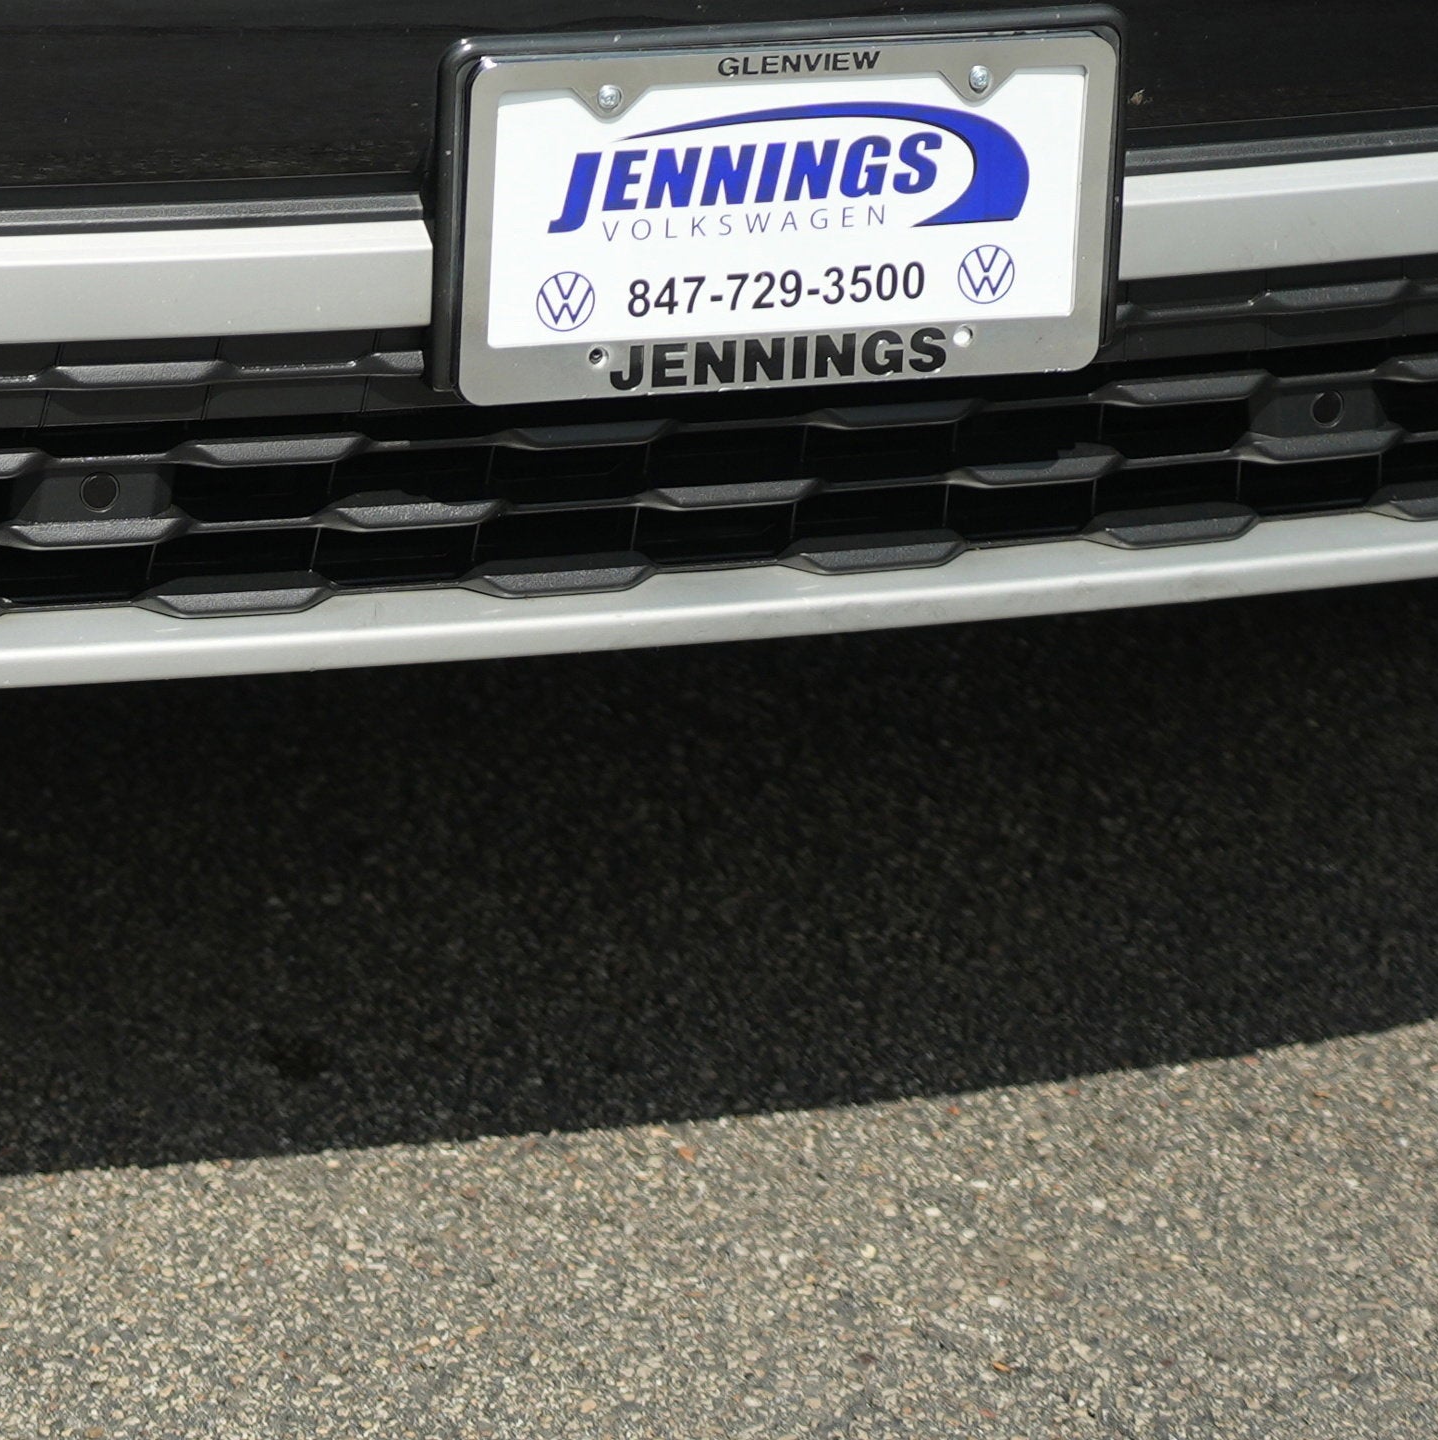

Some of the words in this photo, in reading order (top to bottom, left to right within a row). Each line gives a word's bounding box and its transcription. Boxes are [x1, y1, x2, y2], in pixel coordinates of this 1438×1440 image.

[717, 51, 880, 76] GLENVIEW
[547, 132, 943, 233] JENNINGS
[602, 205, 887, 242] VOLKSWAGEN
[627, 261, 926, 318] 847-729-3500
[609, 327, 948, 391] JENNINGS
